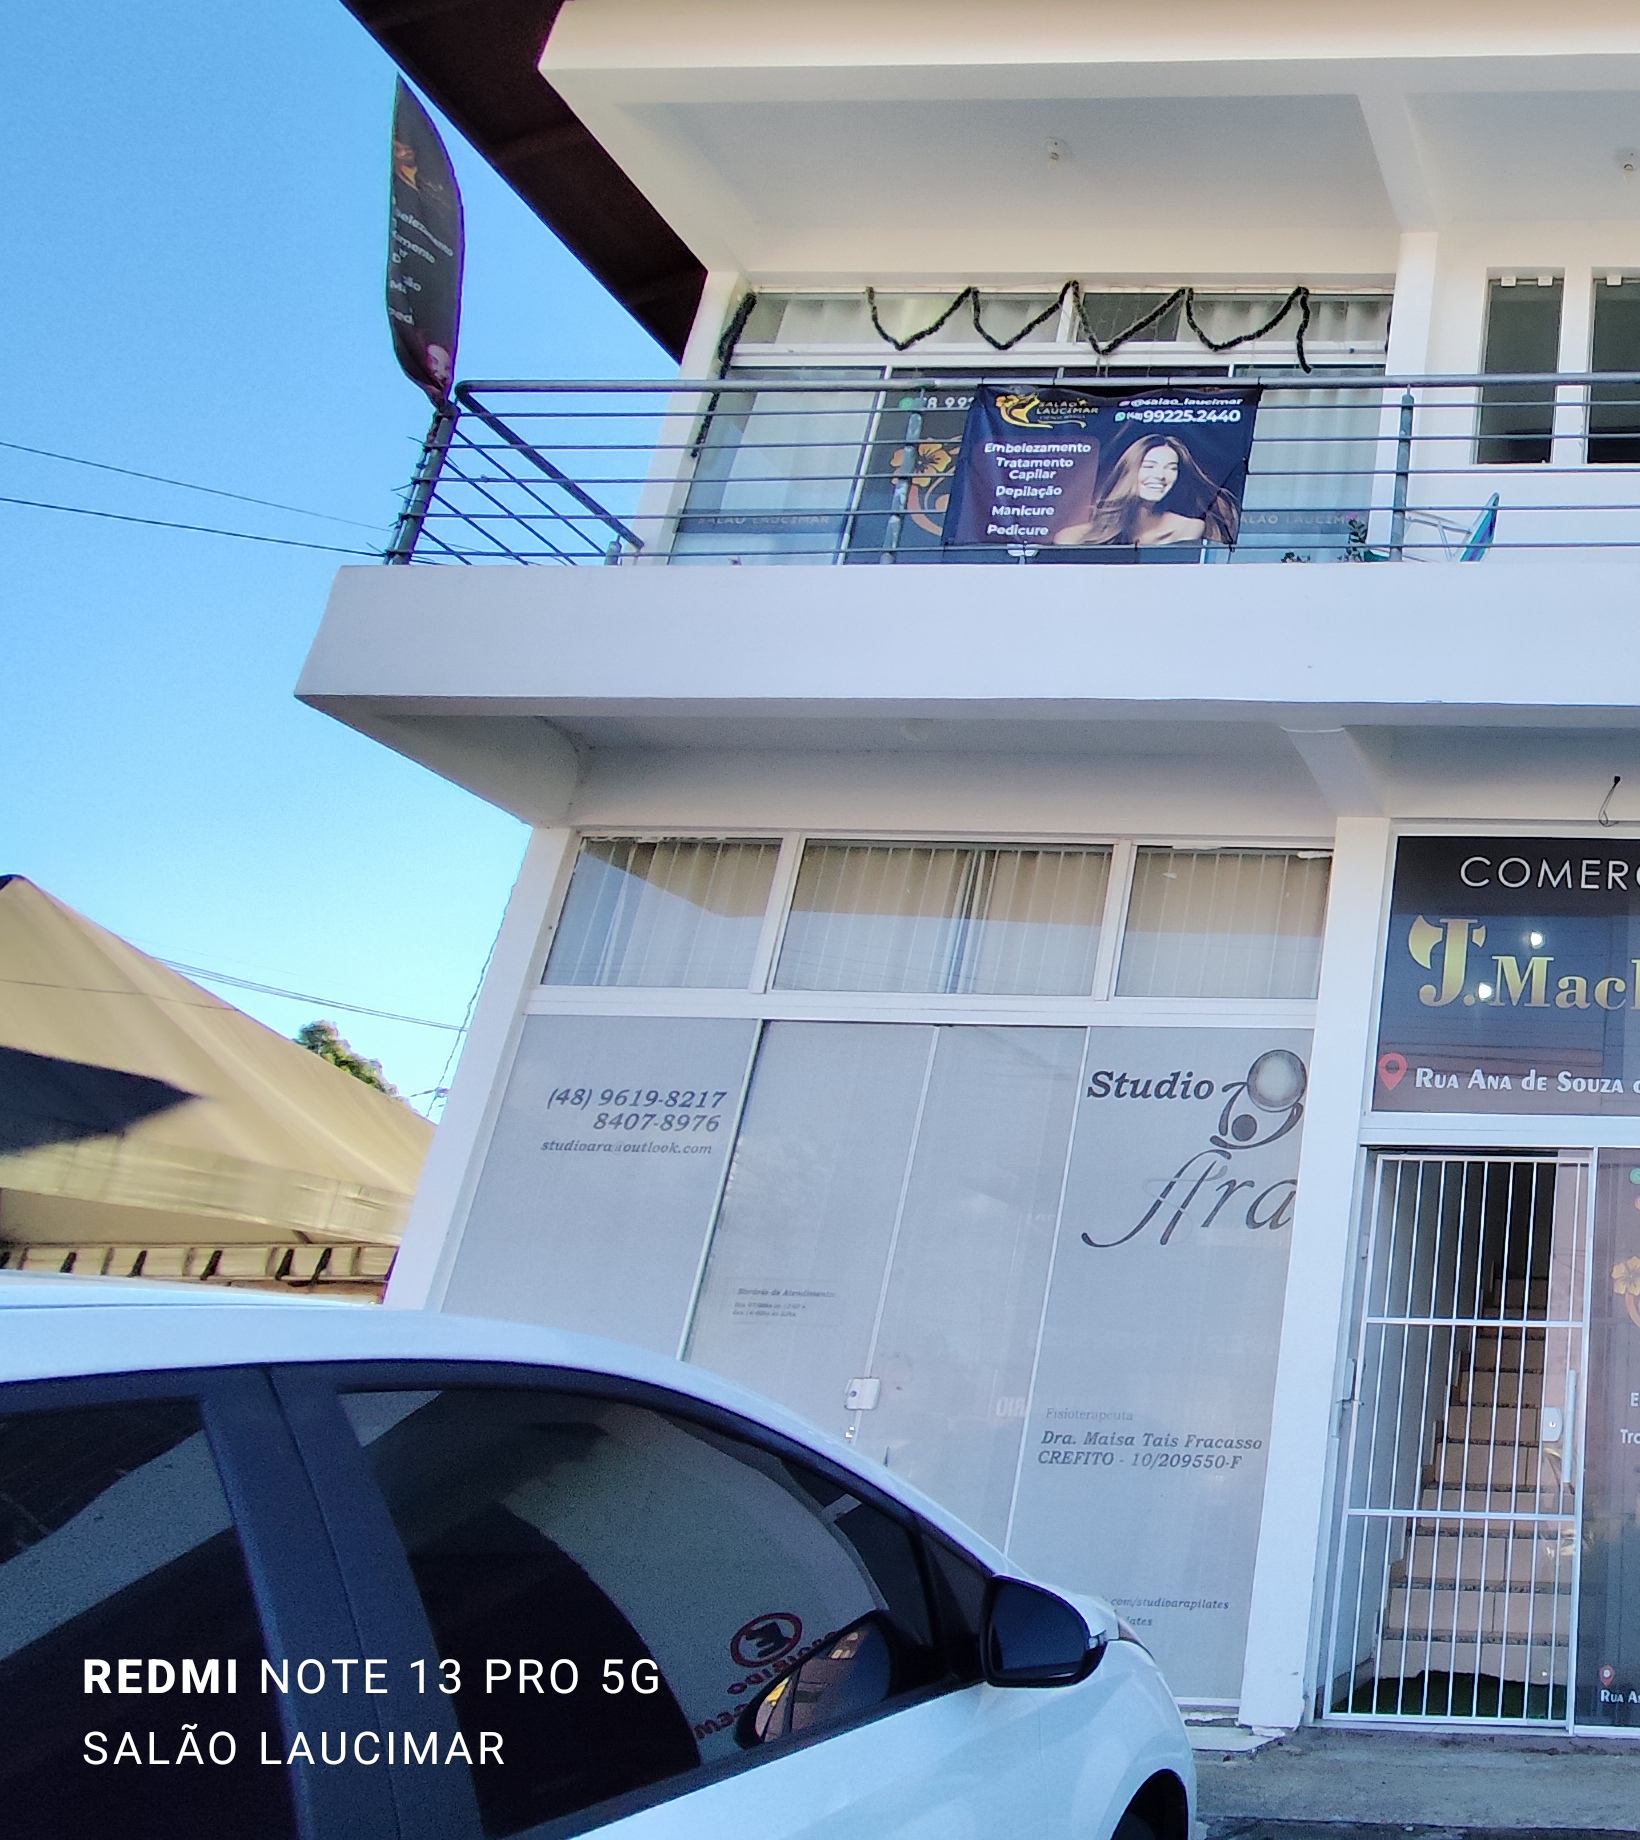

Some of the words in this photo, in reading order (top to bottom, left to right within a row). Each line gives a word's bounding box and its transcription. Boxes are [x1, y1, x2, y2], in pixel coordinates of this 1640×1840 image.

[984, 443, 1091, 453] Embelezamento
[996, 457, 1074, 468] Tratamento
[1009, 469, 1057, 481] Capilar
[995, 486, 1062, 499] Depilação
[991, 505, 1055, 516] Manicure
[987, 524, 1049, 536] Pedicure
[1086, 1070, 1215, 1100] Studio
[547, 1088, 592, 1110] (48)
[598, 1089, 727, 1109] 9619-8217
[593, 1113, 721, 1132] 8407-8976
[1041, 1430, 1077, 1445] Dra.
[1083, 1431, 1136, 1447] Maisa
[1184, 1434, 1262, 1450] Fracasso
[1037, 1450, 1114, 1466] CREFITO
[1131, 1453, 1242, 1470] 10/209550-F
